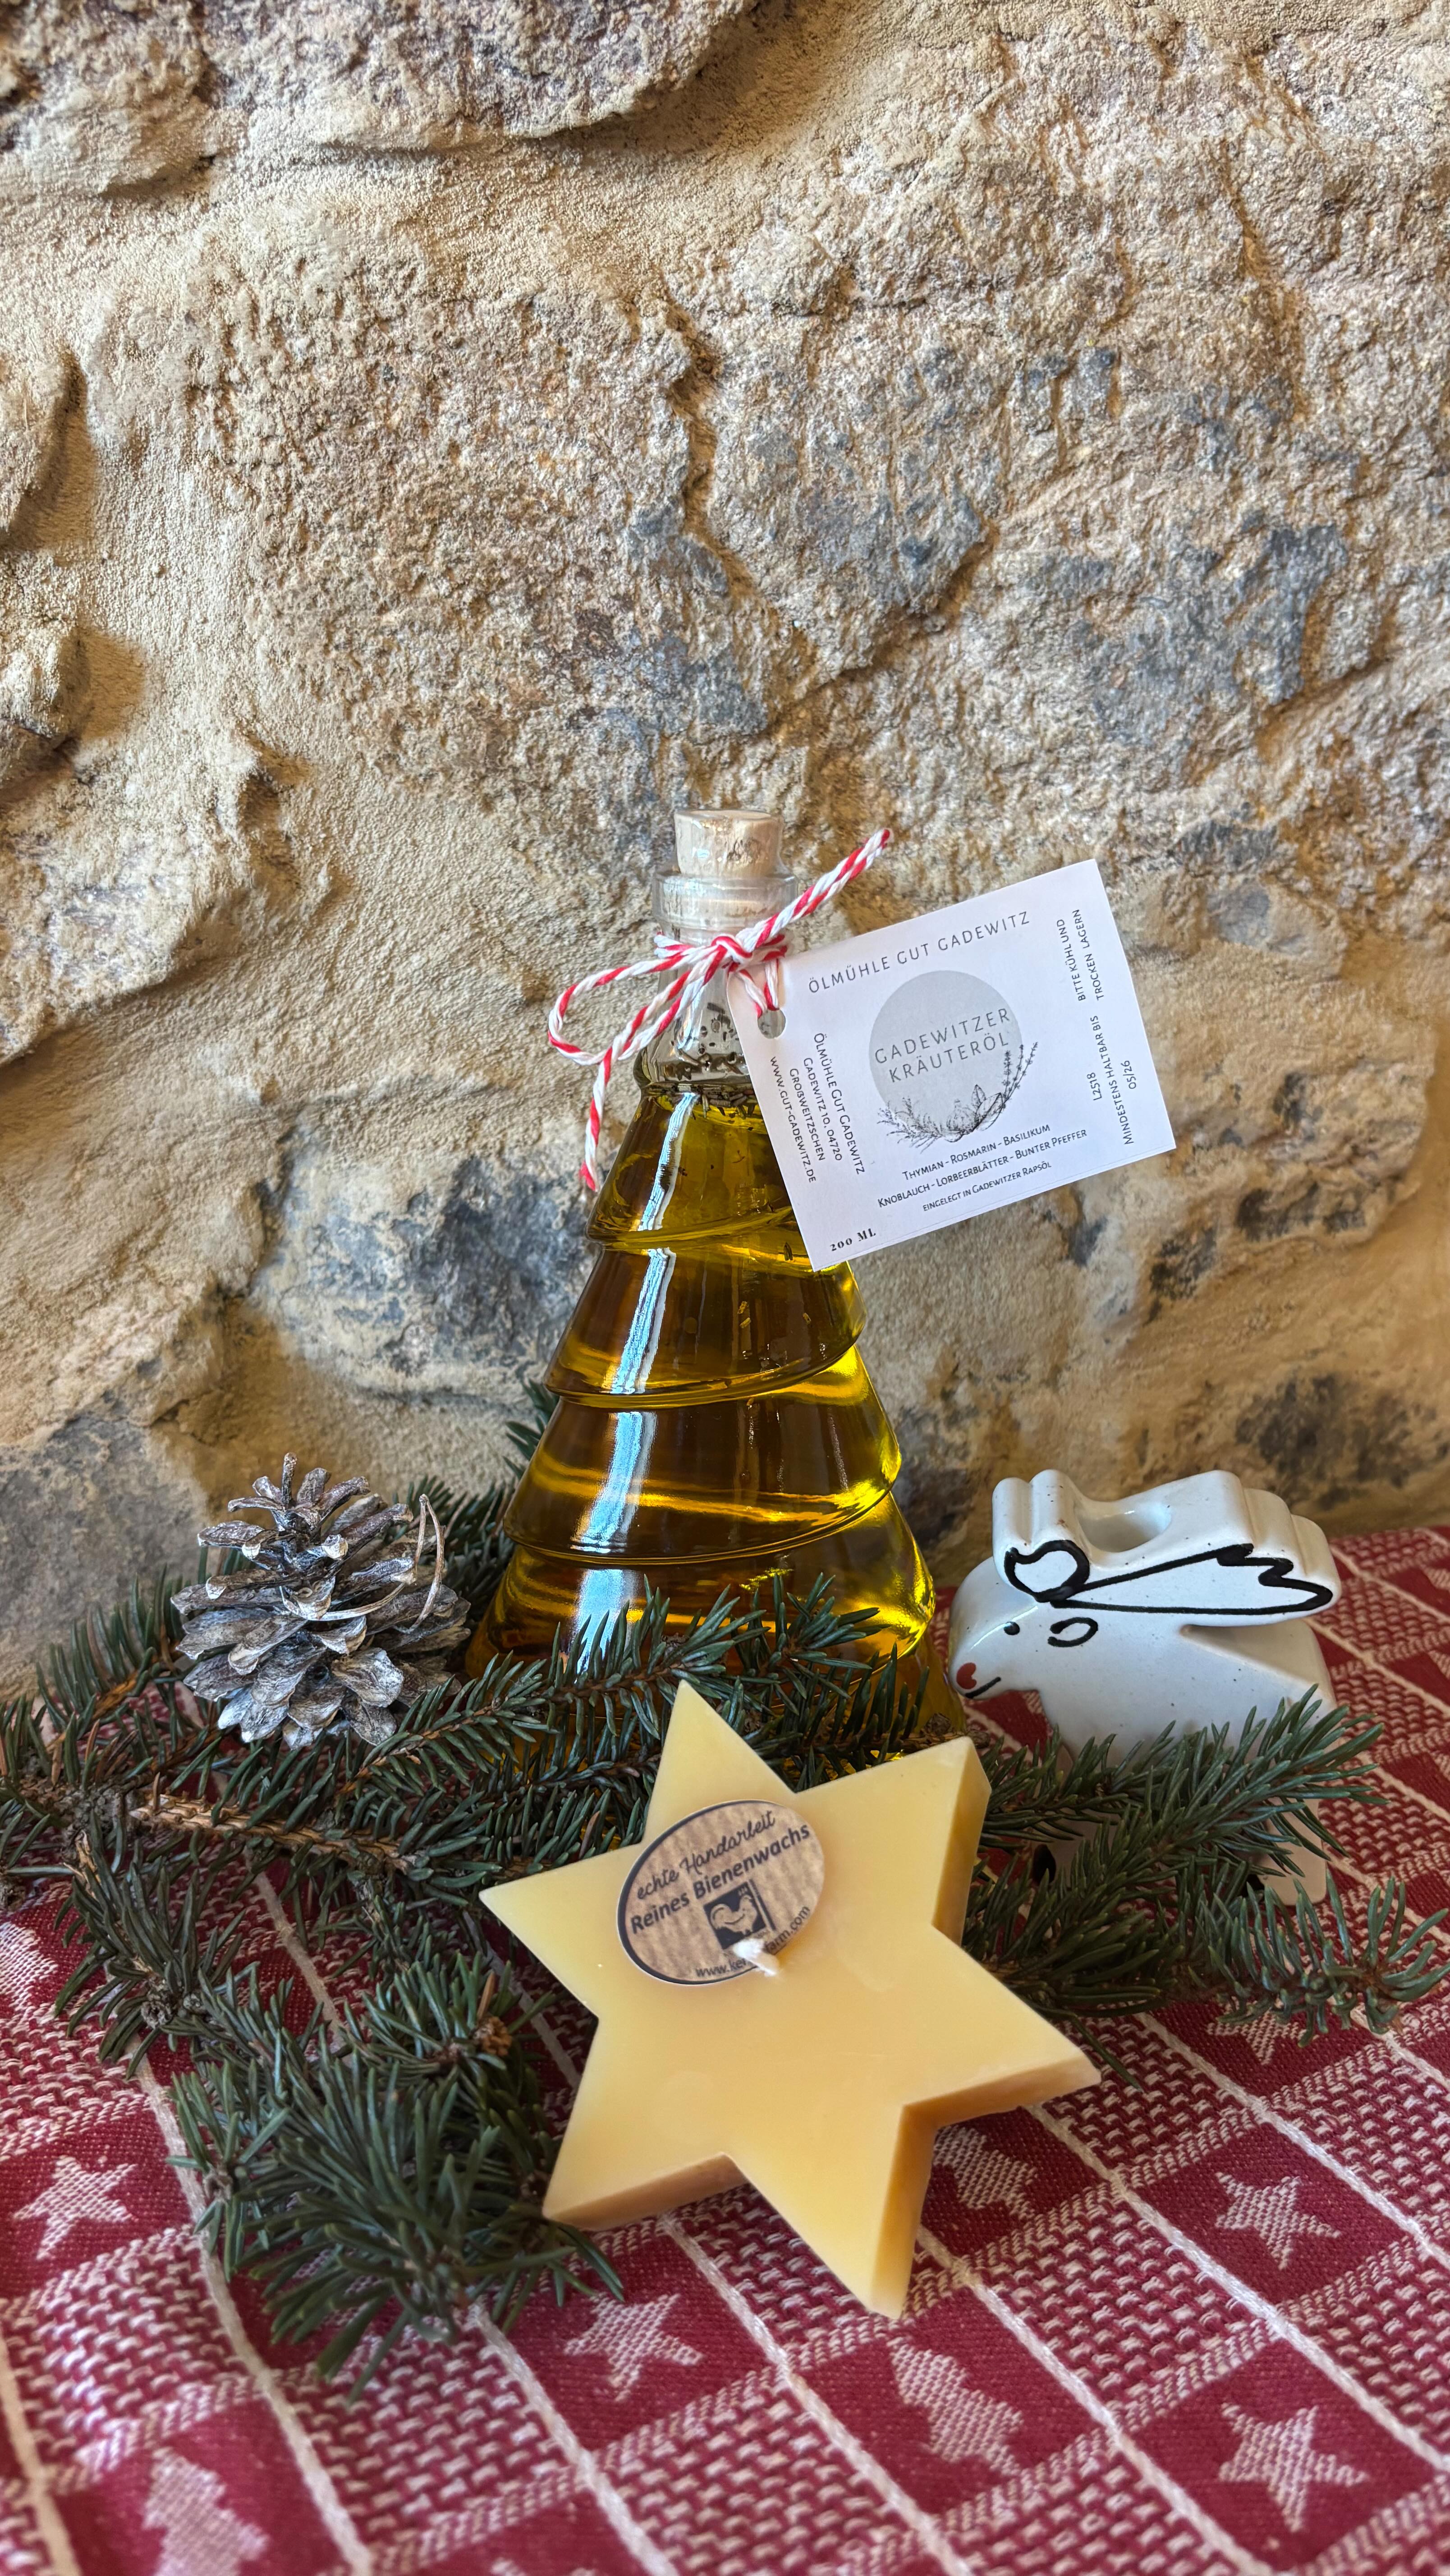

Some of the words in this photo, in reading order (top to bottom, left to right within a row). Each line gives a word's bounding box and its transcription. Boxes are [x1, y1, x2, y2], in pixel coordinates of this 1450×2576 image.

[1056, 919, 1069, 943] UND
[1072, 909, 1090, 948] LAGERN
[808, 956, 890, 993] ÖLMÜHLE
[897, 943, 929, 964] GUT
[938, 911, 1029, 951] GADEWITZ
[1065, 943, 1078, 972] KÜHL
[1072, 973, 1086, 1001] BITTE
[1084, 953, 1104, 1001] TROCKEN
[875, 1008, 1010, 1064] GADEWITZER
[1090, 1016, 1101, 1031] BIS
[890, 1032, 1009, 1083] KRÄUTERÖL
[1095, 1033, 1115, 1078] HALTBAR
[1121, 1060, 1136, 1089] 05/26
[1087, 1072, 1102, 1100] L2518
[1109, 1080, 1134, 1145] MINDESTENS
[827, 1129, 842, 1161] 04720
[830, 1238, 852, 1251] 200
[857, 1228, 876, 1242] ML
[638, 1868, 679, 1899] echte
[679, 1810, 776, 1875] Handarbeit
[631, 1892, 690, 1934] Reines
[693, 1824, 810, 1900] Bienenwachs
